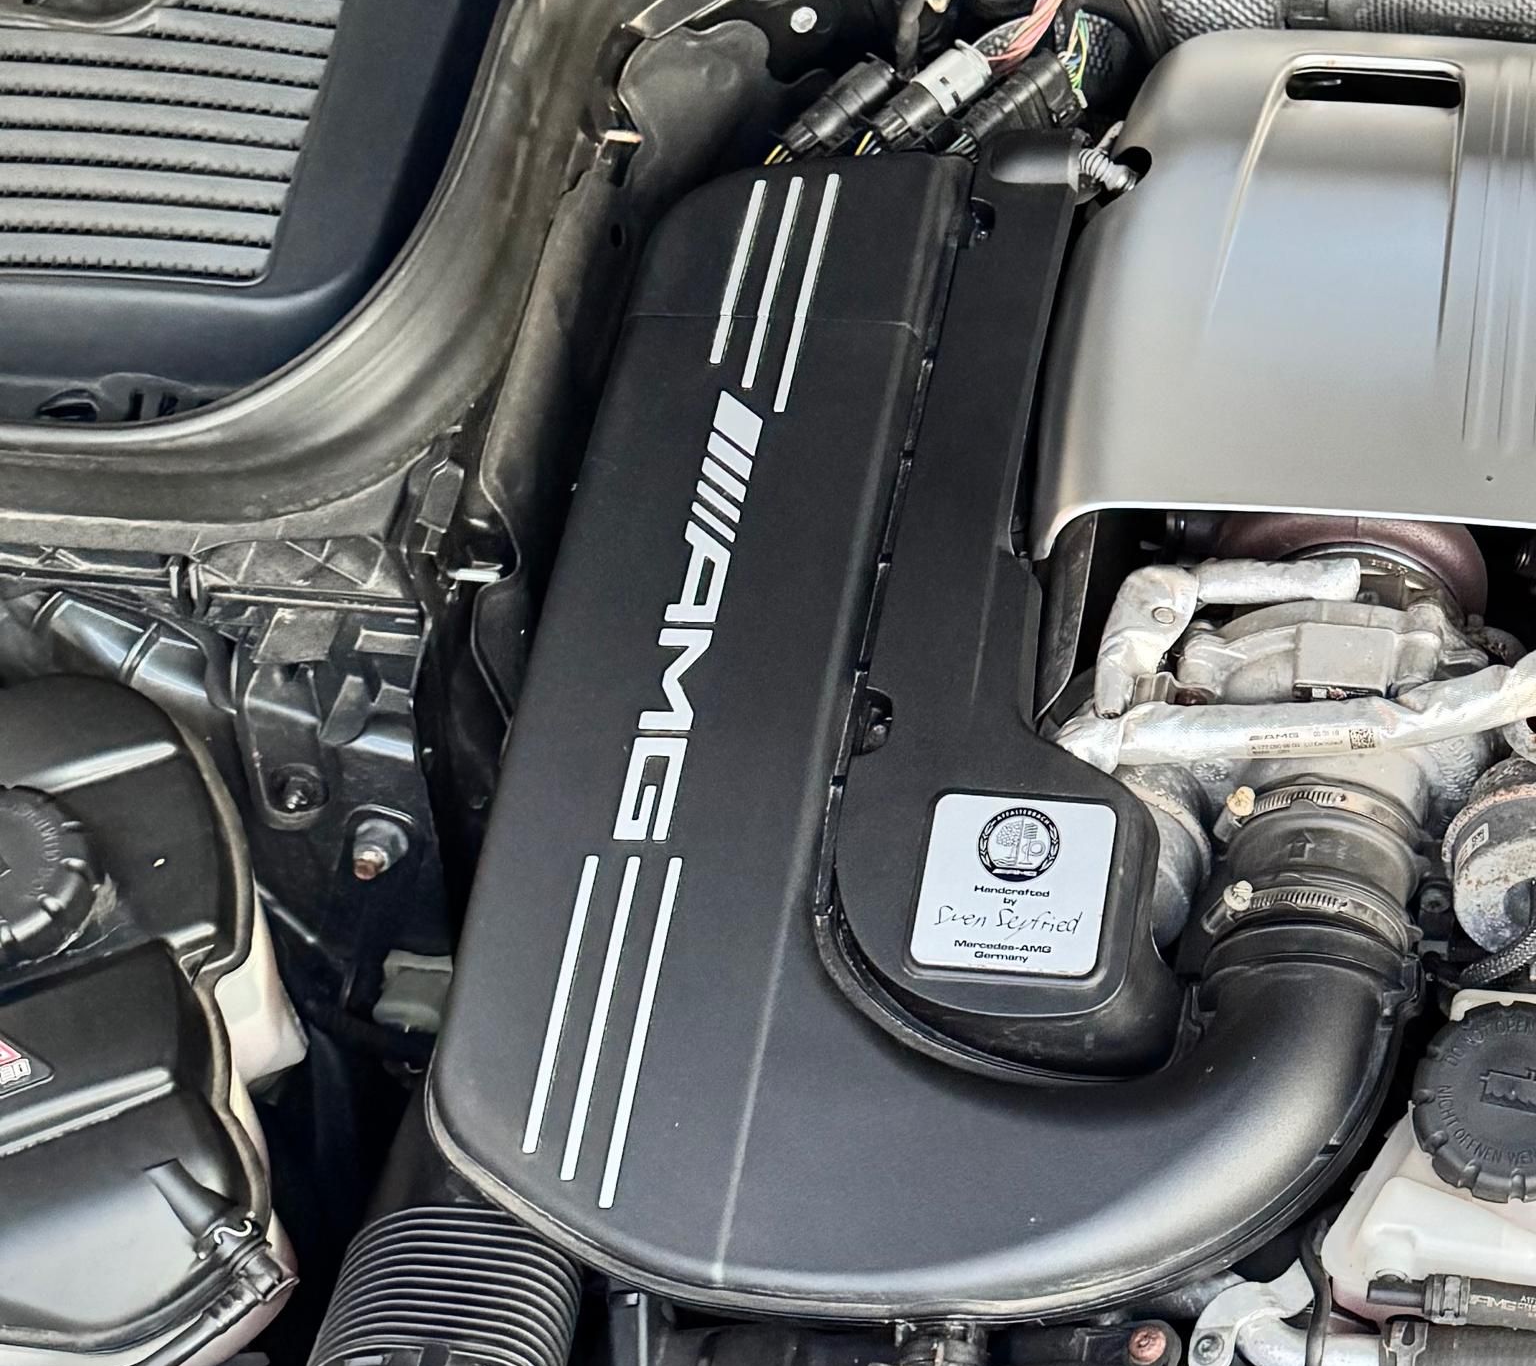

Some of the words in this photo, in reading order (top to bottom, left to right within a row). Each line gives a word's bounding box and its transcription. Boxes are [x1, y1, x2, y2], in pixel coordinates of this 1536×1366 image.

[613, 520, 731, 842] AMG
[974, 885, 1050, 898] Handcrafted
[1003, 897, 1016, 906] by
[954, 939, 1052, 953] Mercedes-AMG
[974, 951, 1028, 963] Germany
[1495, 1022, 1536, 1035] OPEN
[1437, 1085, 1458, 1127] NICHT
